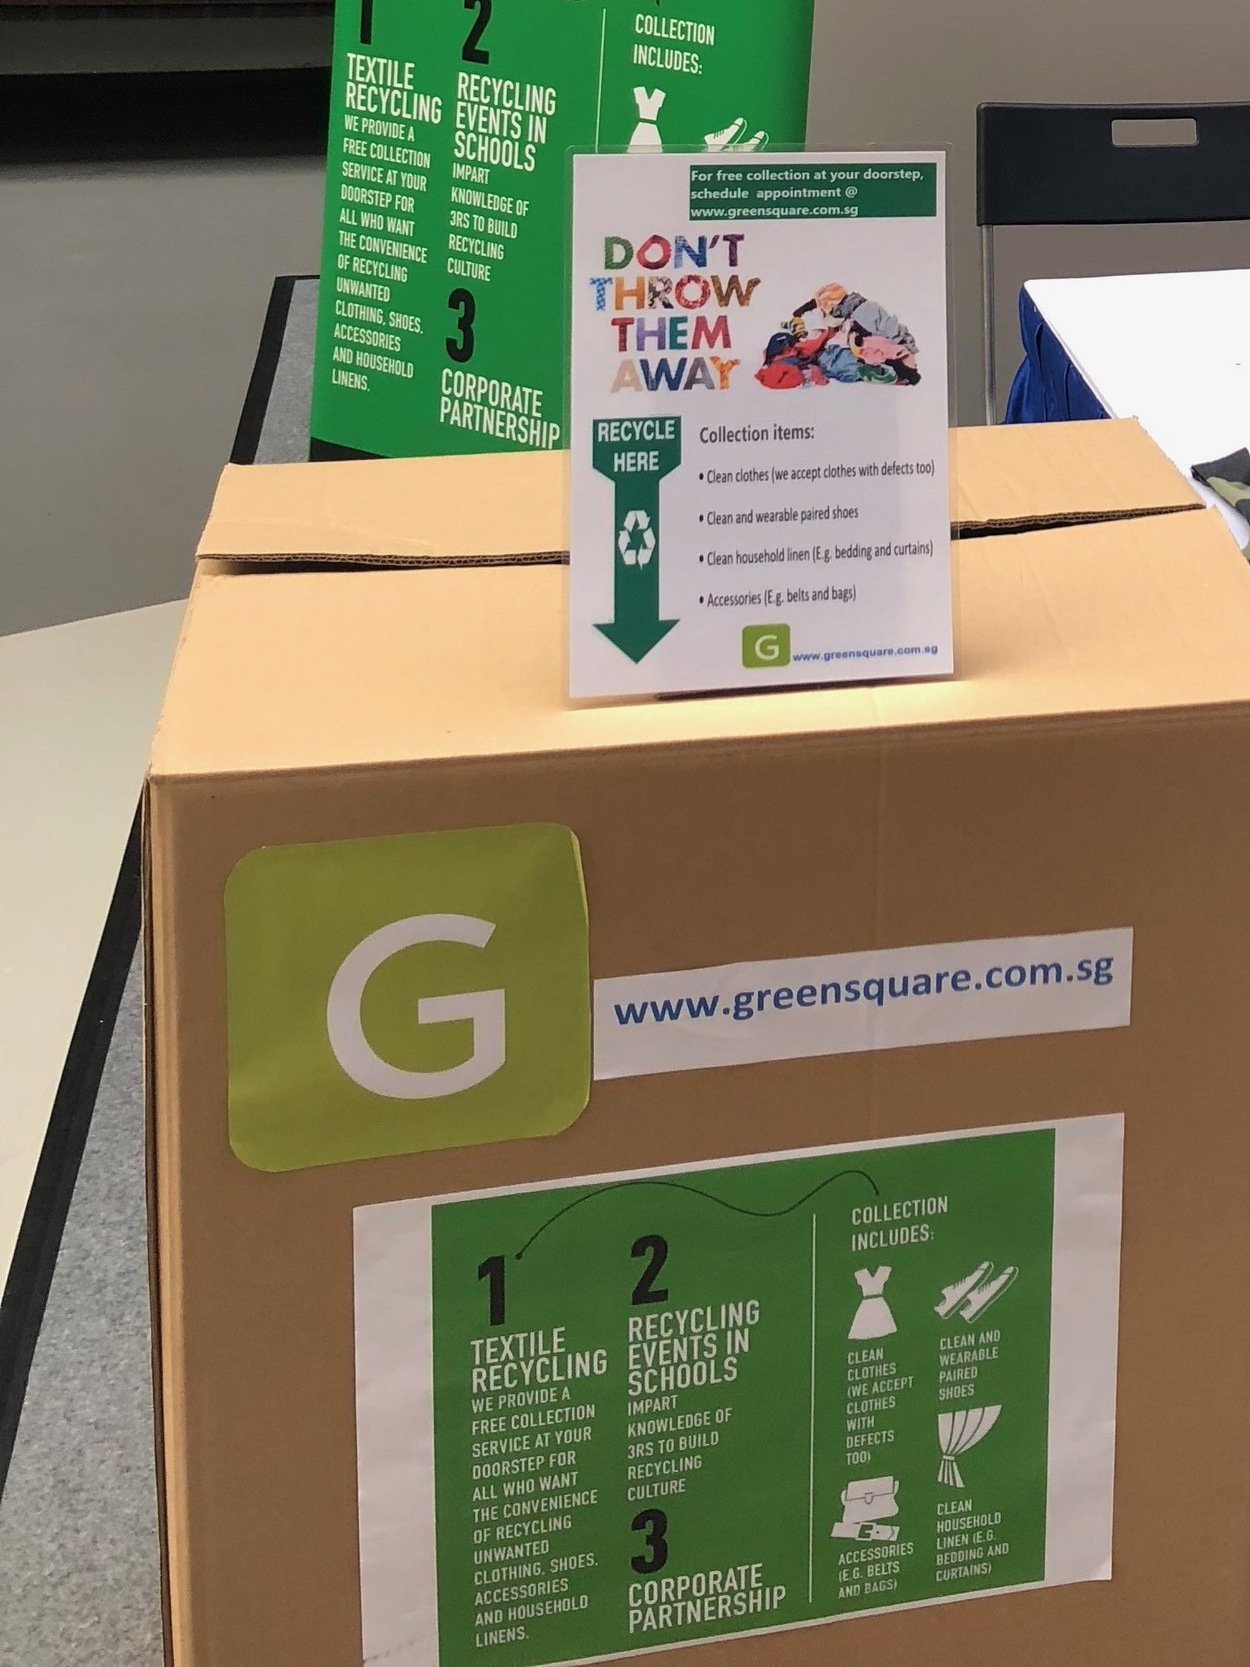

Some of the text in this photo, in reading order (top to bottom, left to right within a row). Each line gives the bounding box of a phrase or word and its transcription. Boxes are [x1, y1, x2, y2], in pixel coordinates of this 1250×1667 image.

[635, 13, 715, 46] COLLECTION
[347, 53, 414, 91] TEXTILE
[633, 45, 702, 75] INCLUDES:
[345, 82, 443, 125] RECYCLING
[458, 71, 557, 116] RECYCLING
[456, 101, 547, 145] EVENTS IN
[454, 131, 536, 172] SCHOOLS
[691, 167, 924, 183] For free collection at your doorstep,
[691, 186, 858, 201] schedule appointment @
[691, 205, 858, 219] www.greensquare.com.sg
[604, 234, 745, 271] DON'T
[588, 275, 761, 312] THROW
[446, 288, 475, 363] 3
[611, 315, 732, 352] THEM
[442, 368, 543, 418] CORPORATE
[610, 355, 741, 393] AWAY
[440, 397, 561, 449] PARTNERSHIP
[598, 420, 675, 442] RECYCLE
[700, 424, 815, 444] Collection items:
[613, 451, 659, 472] HERE
[707, 460, 934, 484] Clean clothes (we accept clothes with defects too)
[707, 506, 859, 525] Clean and wearable paired shoes
[707, 539, 934, 566] Clean household linen (E.g. bedding and curtains)
[707, 585, 856, 607] Accessories (E.g. belts and bags)
[792, 643, 938, 662] www.greensquare.com.sg
[327, 913, 505, 1099] G
[614, 953, 1114, 1025] www.greensquare.com.sg
[852, 1196, 948, 1226] COLLECTION
[851, 1224, 935, 1252] INCLUDES:
[630, 1234, 669, 1306] 2
[477, 1255, 505, 1326] 1
[628, 1299, 760, 1342] RECYCLING
[471, 1327, 566, 1366] TEXTILE
[628, 1328, 750, 1371] EVENTS IN
[471, 1349, 607, 1394] RECYCLING
[628, 1358, 738, 1396] SCHOOLS
[630, 1508, 668, 1575] 3
[628, 1564, 763, 1608] CORPORATE
[628, 1585, 786, 1634] PARTNERSHIP
